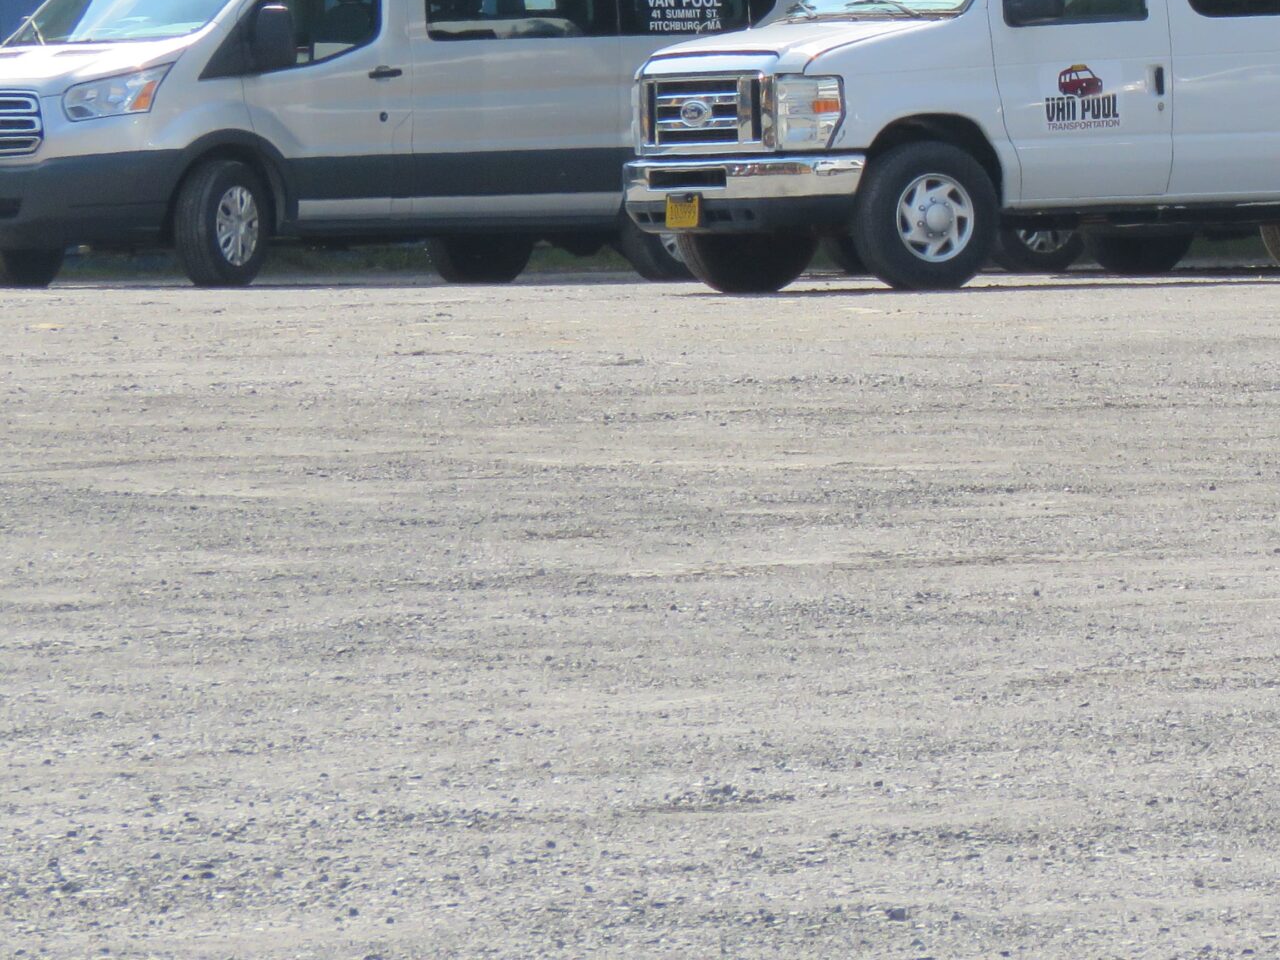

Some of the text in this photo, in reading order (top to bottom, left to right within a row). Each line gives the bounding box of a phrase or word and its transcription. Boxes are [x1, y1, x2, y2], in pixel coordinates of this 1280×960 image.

[651, 9, 661, 19] 41
[665, 8, 701, 19] SUMMIT
[707, 20, 722, 30] MA
[1045, 93, 1119, 122] VAN POOL
[1047, 119, 1120, 131] TRANSPORTATION
